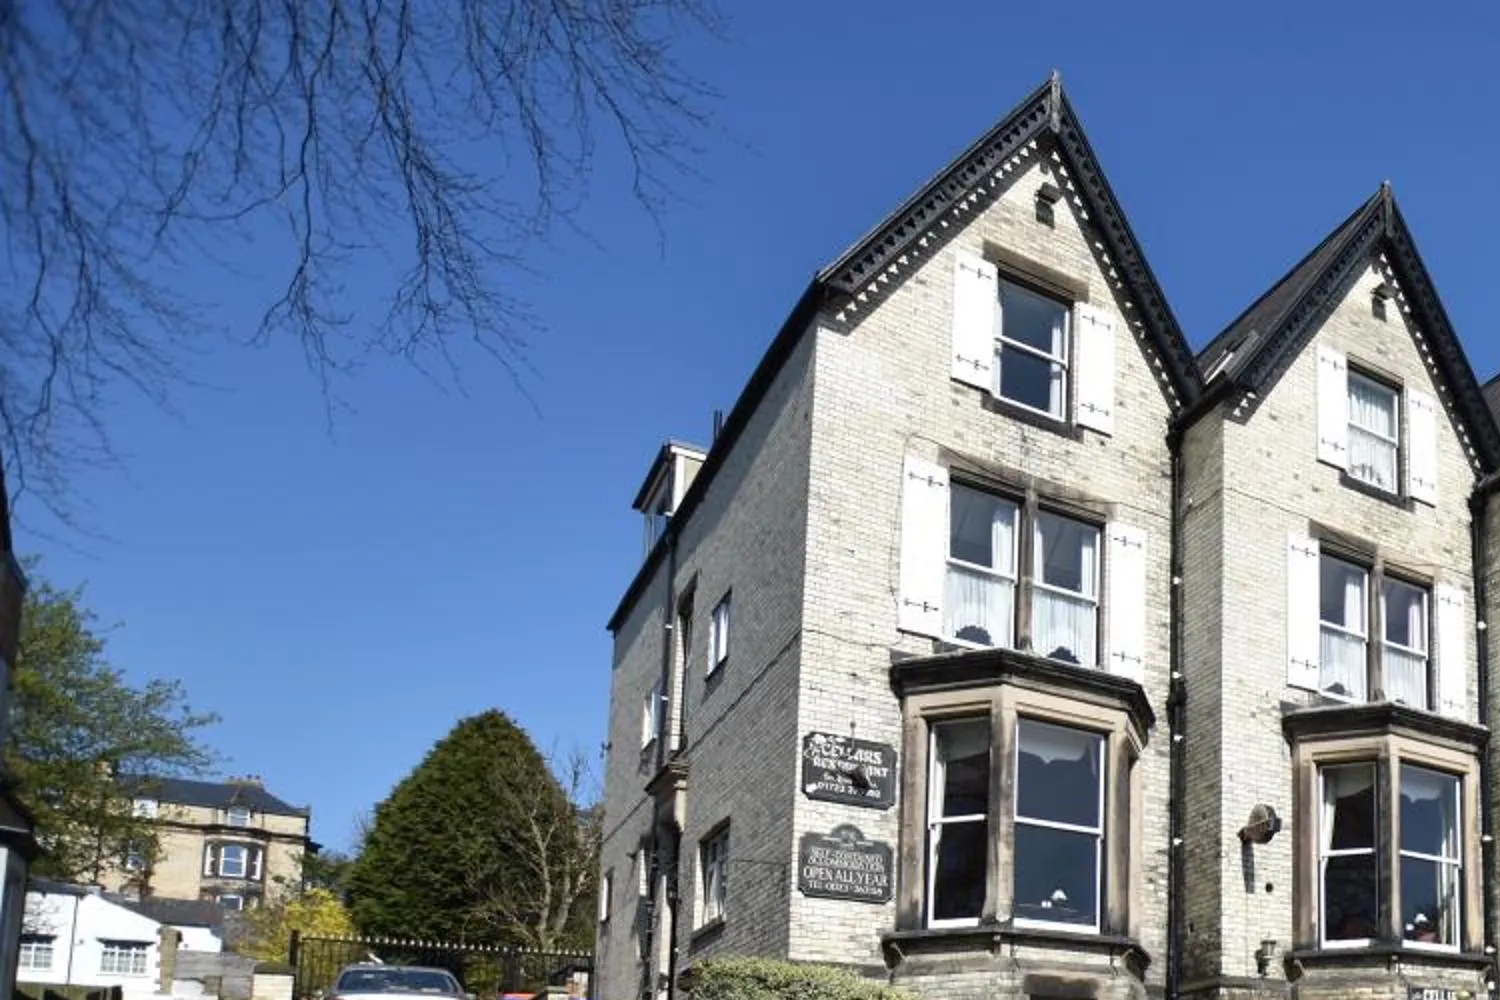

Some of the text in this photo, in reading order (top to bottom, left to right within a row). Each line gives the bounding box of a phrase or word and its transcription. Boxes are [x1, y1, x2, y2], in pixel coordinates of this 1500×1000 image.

[803, 866, 888, 887] OPEN ALL YEAR
